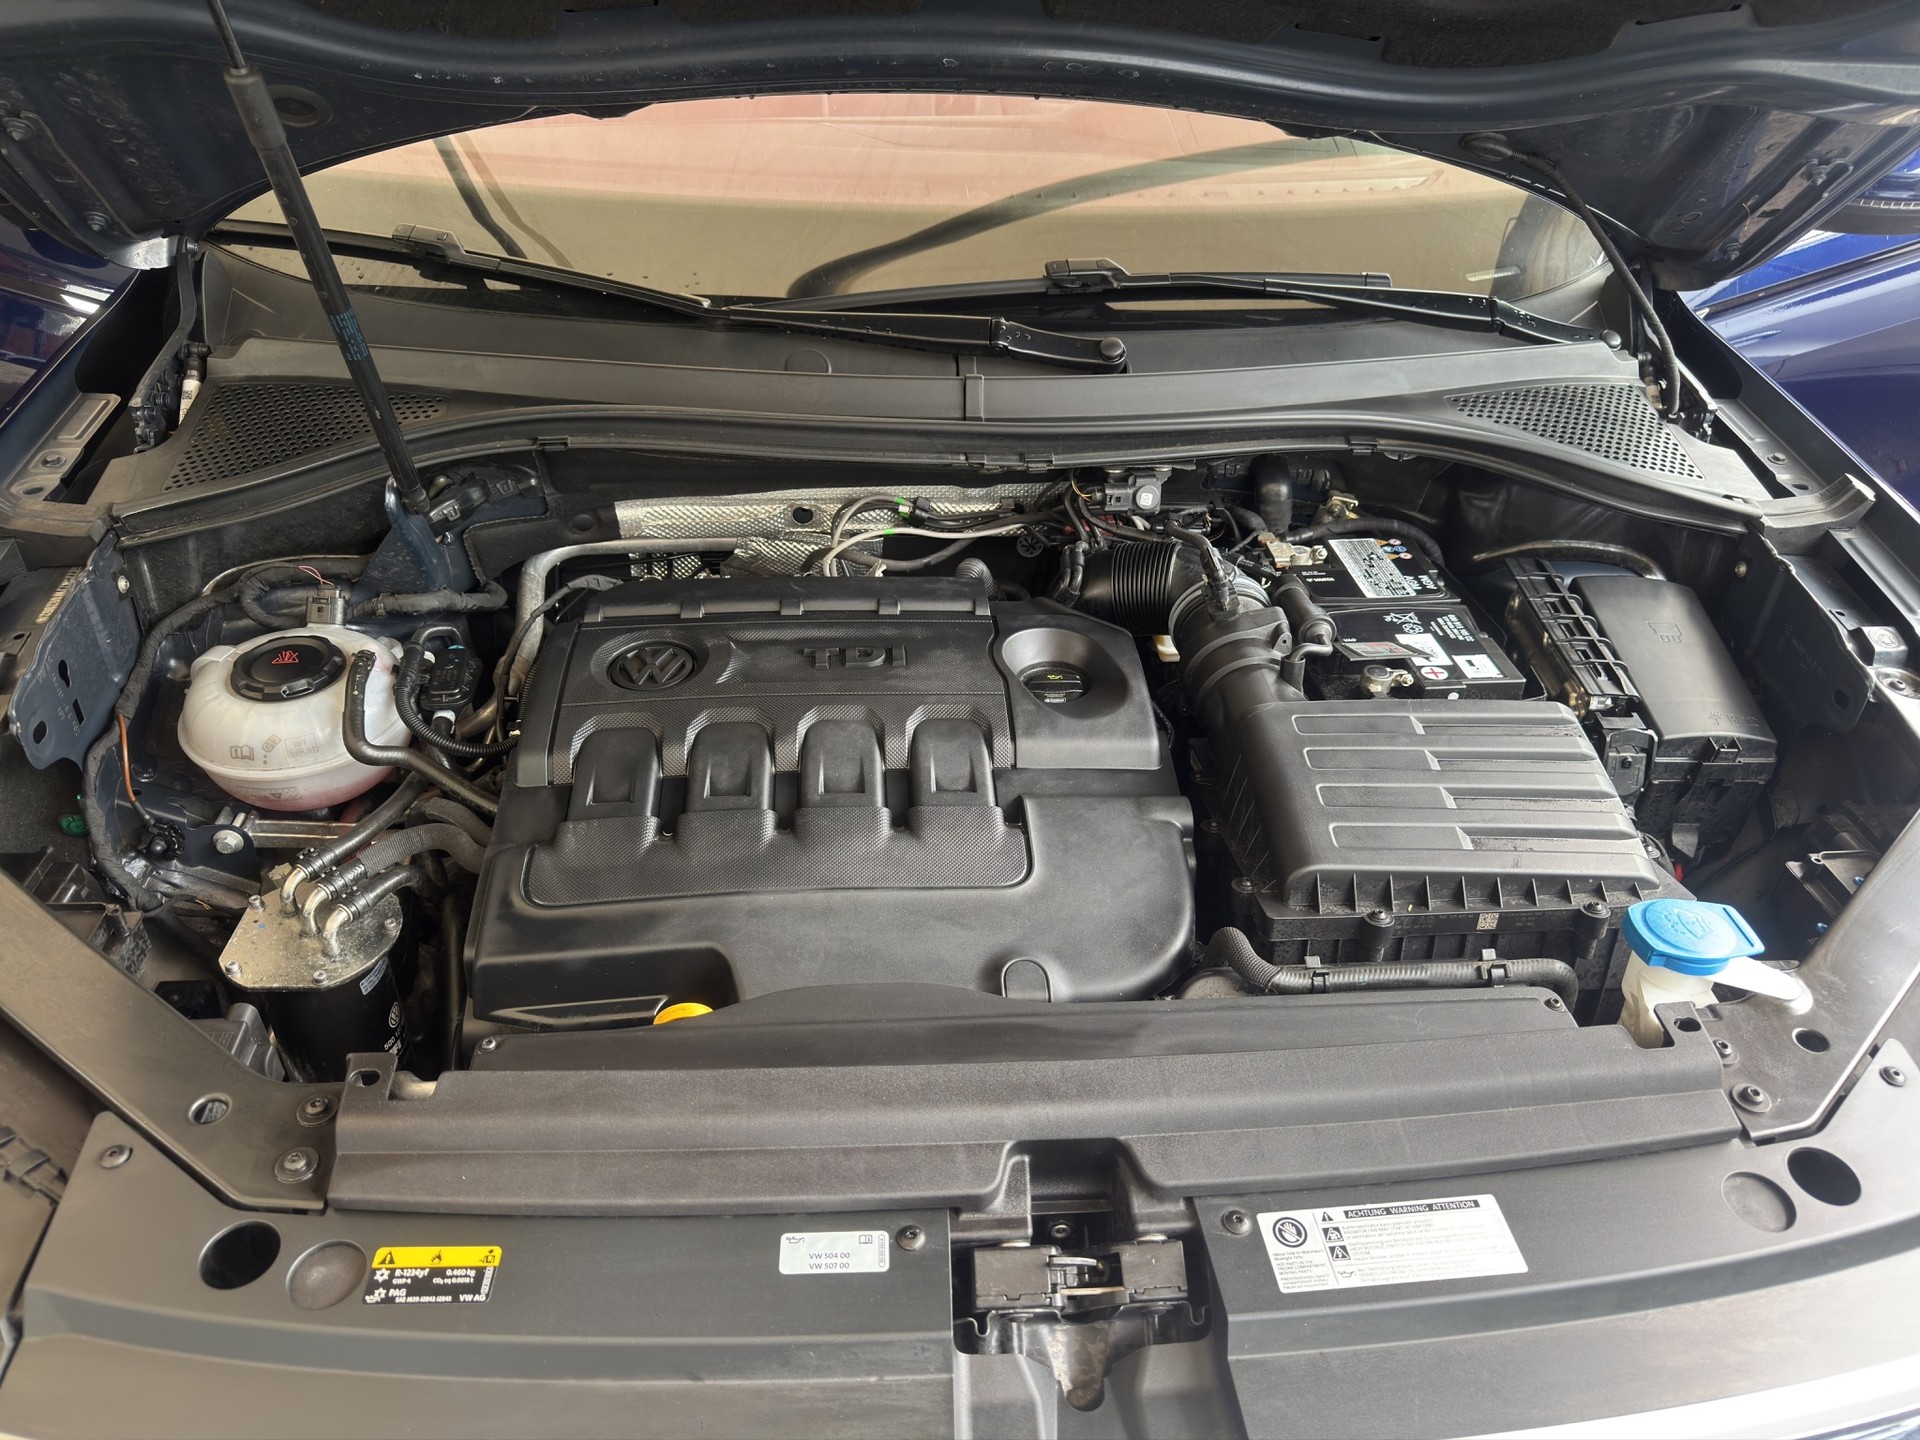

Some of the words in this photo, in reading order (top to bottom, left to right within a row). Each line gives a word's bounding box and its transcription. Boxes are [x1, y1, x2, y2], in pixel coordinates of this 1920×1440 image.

[1403, 576, 1422, 589] AGM
[1418, 575, 1438, 589] AGM
[802, 645, 908, 670] TDI
[1348, 1208, 1386, 1218] ACHTUNG
[1389, 1204, 1429, 1214] WARNING
[1432, 1200, 1475, 1211] ATTENTION
[394, 1268, 430, 1278] R-1234yf
[446, 1268, 466, 1276] 0.460
[466, 1268, 476, 1278] kg
[388, 1288, 407, 1297] PAG
[459, 1294, 473, 1302] VW
[473, 1294, 486, 1302] AG
